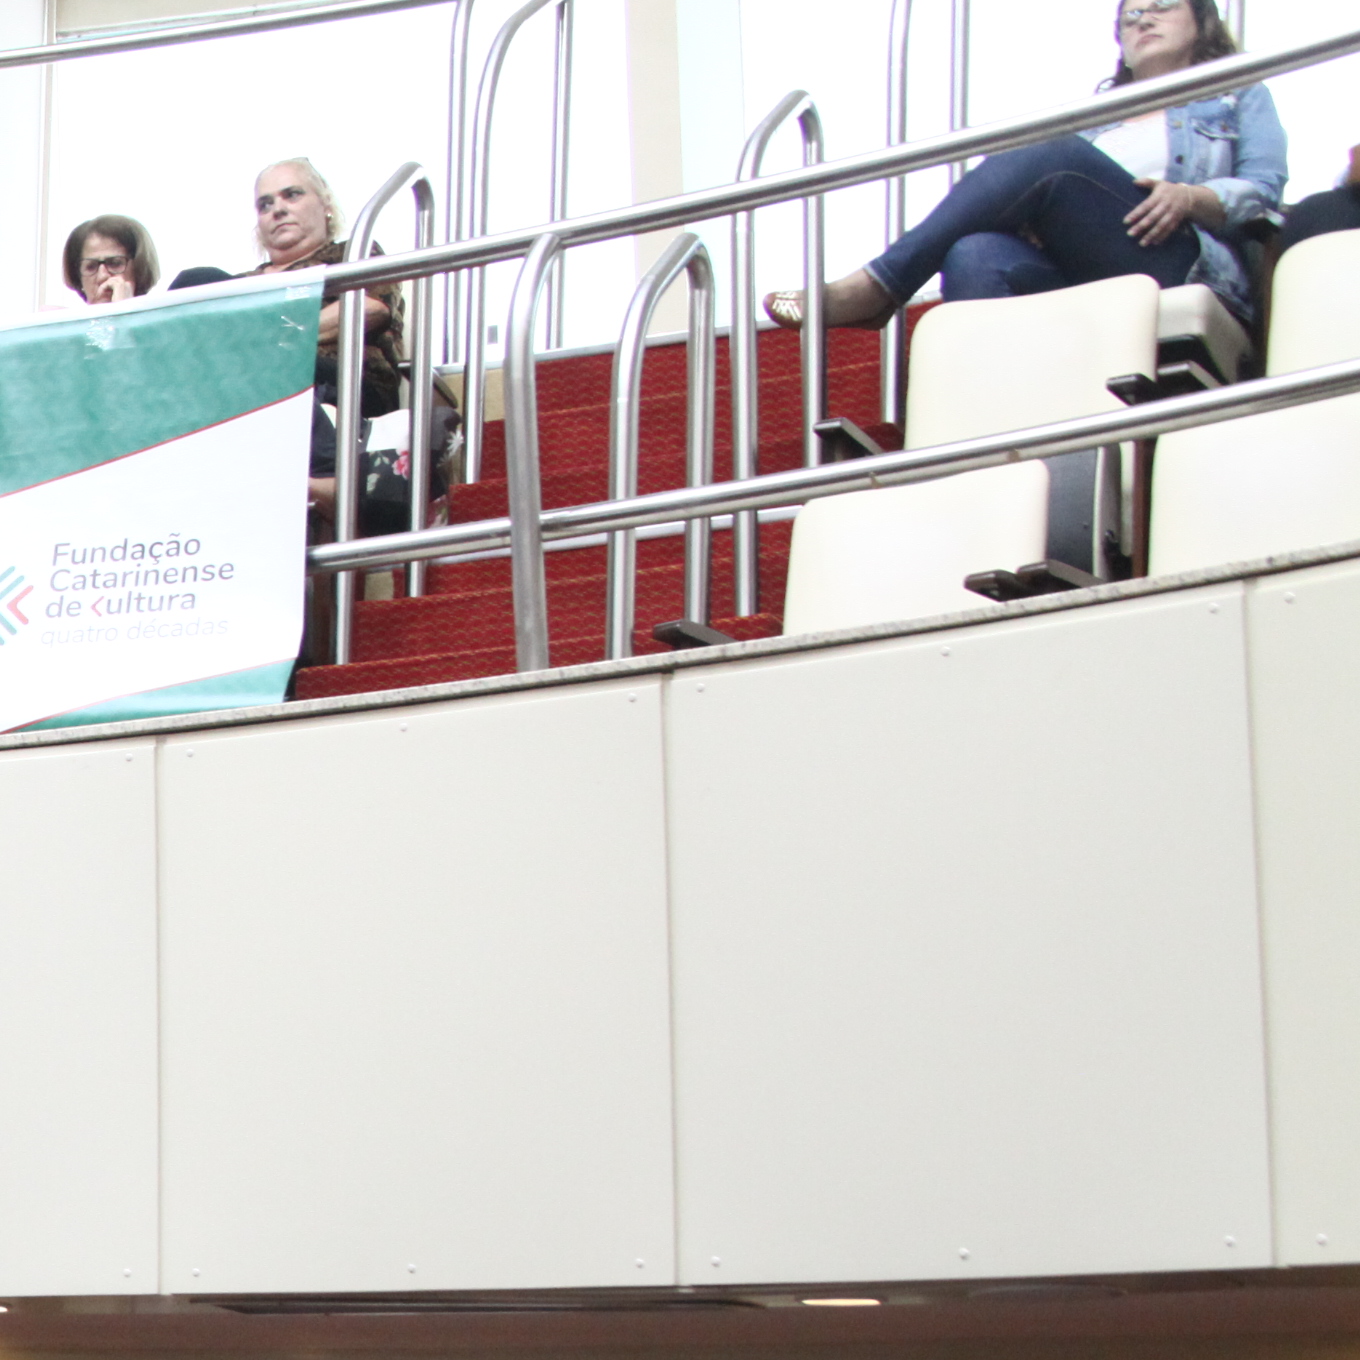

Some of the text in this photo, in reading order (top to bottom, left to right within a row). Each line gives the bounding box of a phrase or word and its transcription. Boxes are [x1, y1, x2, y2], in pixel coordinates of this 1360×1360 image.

[51, 532, 201, 566] Fundação
[49, 562, 235, 592] Catarinense
[44, 594, 81, 618] de
[40, 618, 229, 647] quatro décadas
